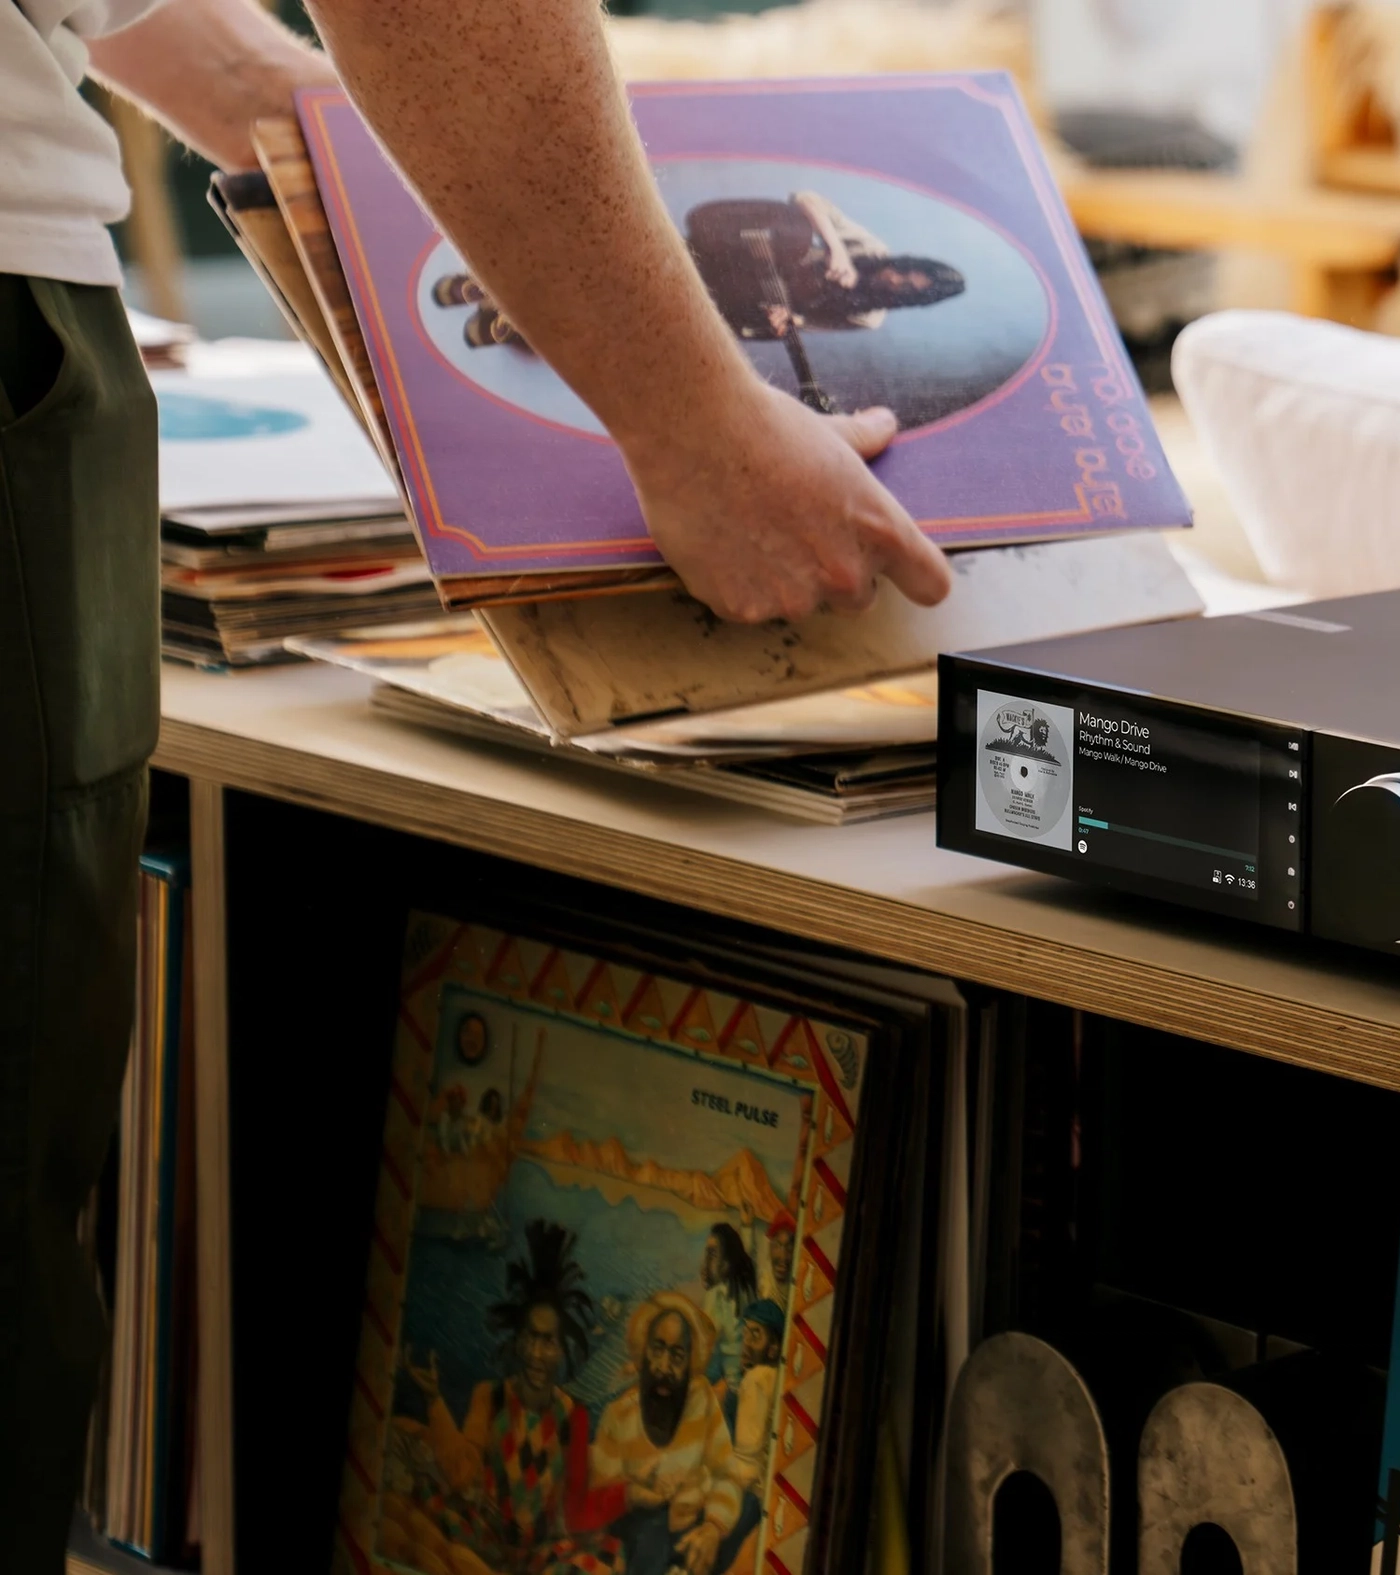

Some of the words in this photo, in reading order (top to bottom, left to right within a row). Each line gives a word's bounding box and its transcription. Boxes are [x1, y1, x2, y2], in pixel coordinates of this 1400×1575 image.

[1079, 711, 1119, 734] Mango
[1120, 720, 1150, 739] Drive
[1079, 730, 1114, 746] Rhythm
[1114, 738, 1121, 749] &
[1122, 739, 1151, 755] Sound
[1079, 746, 1103, 761] Mango
[1124, 756, 1149, 770] Mango
[1149, 761, 1167, 773] Drive
[1238, 877, 1256, 890] 13:36
[691, 1088, 732, 1115] STEEL
[735, 1101, 778, 1128] PULSE
